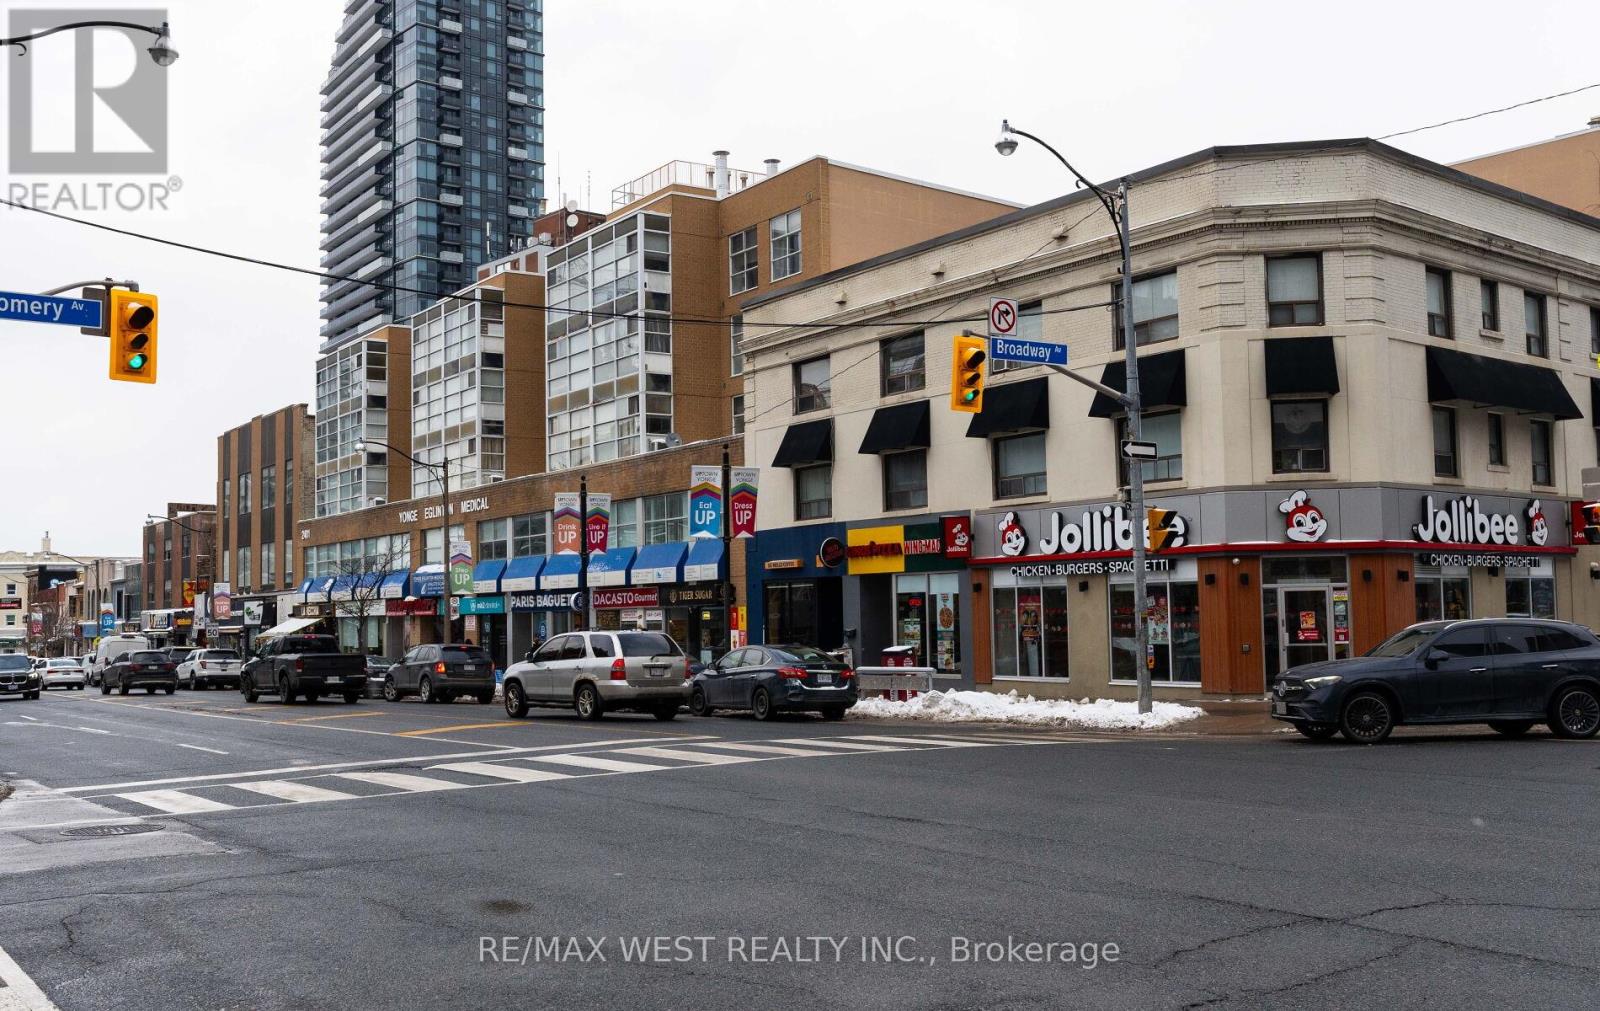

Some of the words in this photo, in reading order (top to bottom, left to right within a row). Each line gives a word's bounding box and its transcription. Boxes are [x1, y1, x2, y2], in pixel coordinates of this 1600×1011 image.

[71, 301, 84, 311] Av
[996, 340, 1051, 361] Broadway
[399, 509, 418, 523] YONGE
[424, 503, 454, 520] EGLINTN
[460, 496, 490, 513] MEDICAL
[699, 501, 712, 509] Eat
[734, 502, 753, 510] Dress
[694, 510, 716, 525] UP
[735, 510, 752, 525] UP
[1417, 495, 1519, 545] Jollibee
[1039, 505, 1186, 554] Jollibe
[558, 531, 577, 544] UP
[590, 530, 605, 544] UP
[1431, 553, 1465, 566] CHICKEN
[1467, 554, 1501, 567] BURGERS
[1010, 565, 1051, 577] CHICKEN
[1055, 562, 1103, 576] BURGERS
[1108, 559, 1169, 574] SPAGETTI
[455, 573, 470, 585] UP
[511, 595, 535, 608] PARIS
[536, 594, 571, 607] BAGUET
[594, 592, 634, 605] DACASTO
[634, 592, 658, 602] Gourmet
[679, 590, 694, 600] TIGER
[694, 589, 713, 600] SUGAR
[216, 605, 229, 613] UP
